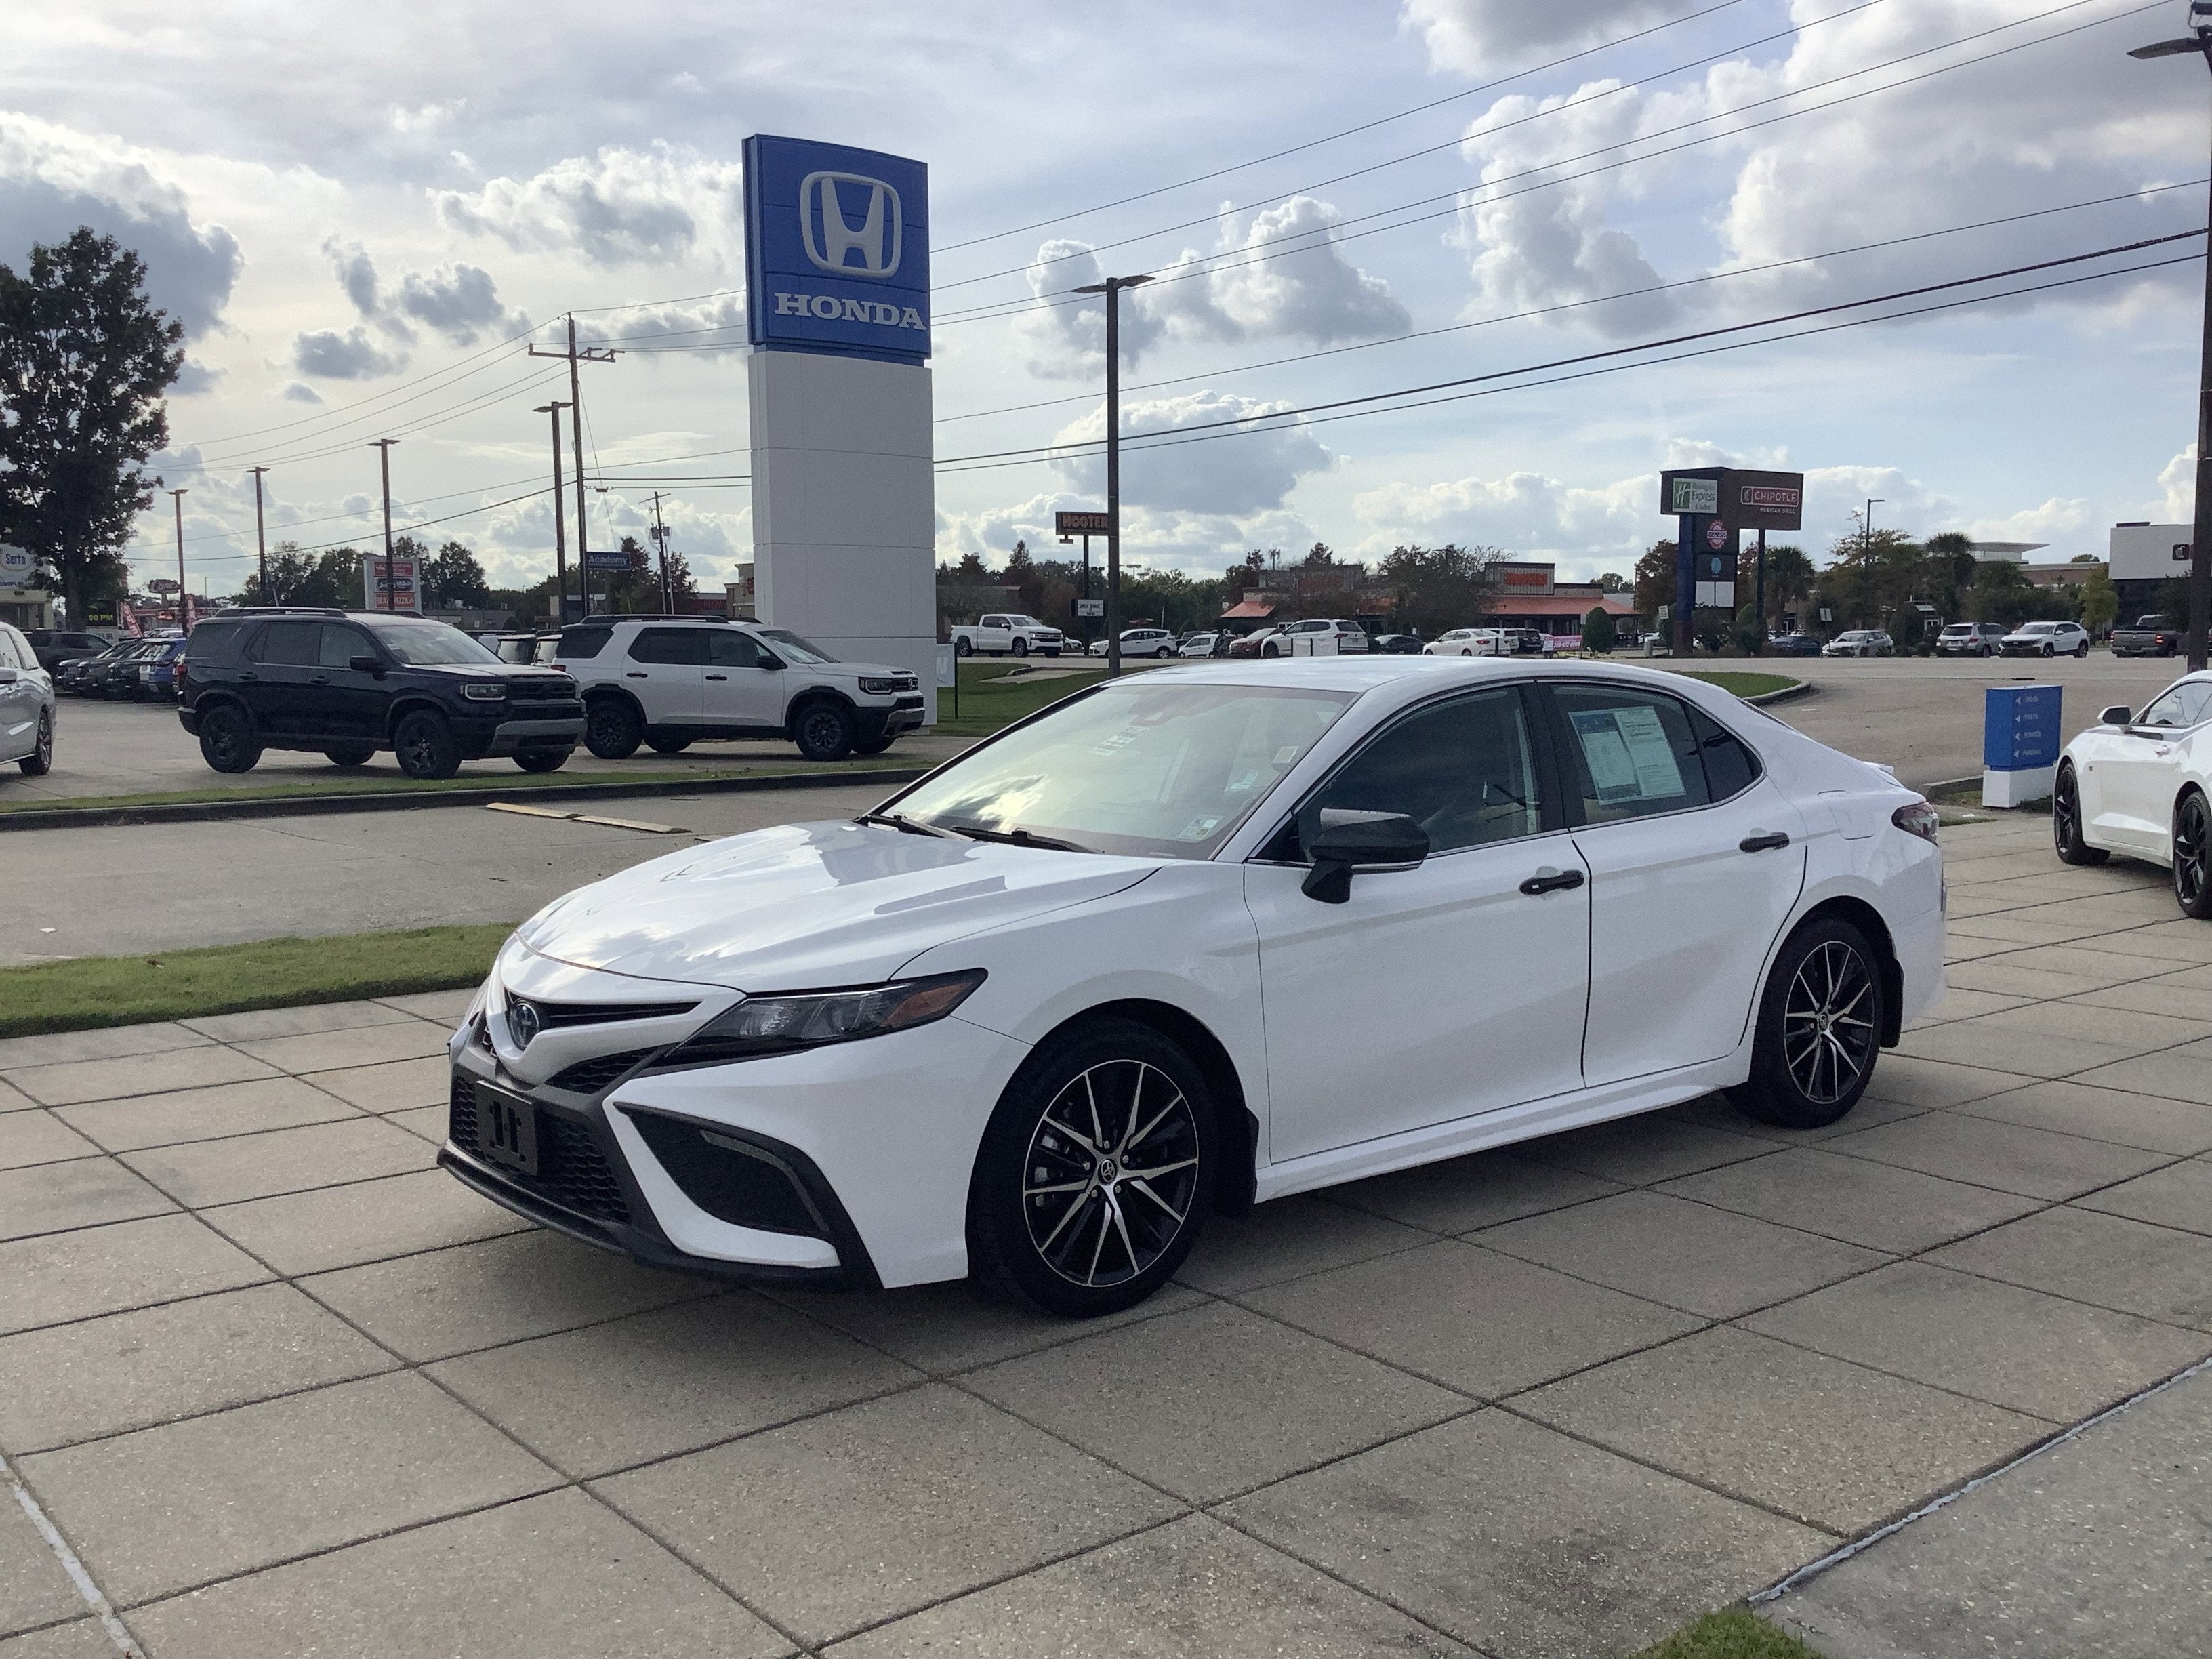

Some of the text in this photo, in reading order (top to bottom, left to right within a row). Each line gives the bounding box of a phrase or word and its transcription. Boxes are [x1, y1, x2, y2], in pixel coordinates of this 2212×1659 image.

[774, 292, 927, 331] HONDA
[1692, 490, 1715, 502] Express
[1754, 491, 1797, 502] CHIPOTLE
[1062, 514, 1109, 529] HOOTER
[5, 553, 26, 565] Serta
[589, 555, 628, 565] Academy
